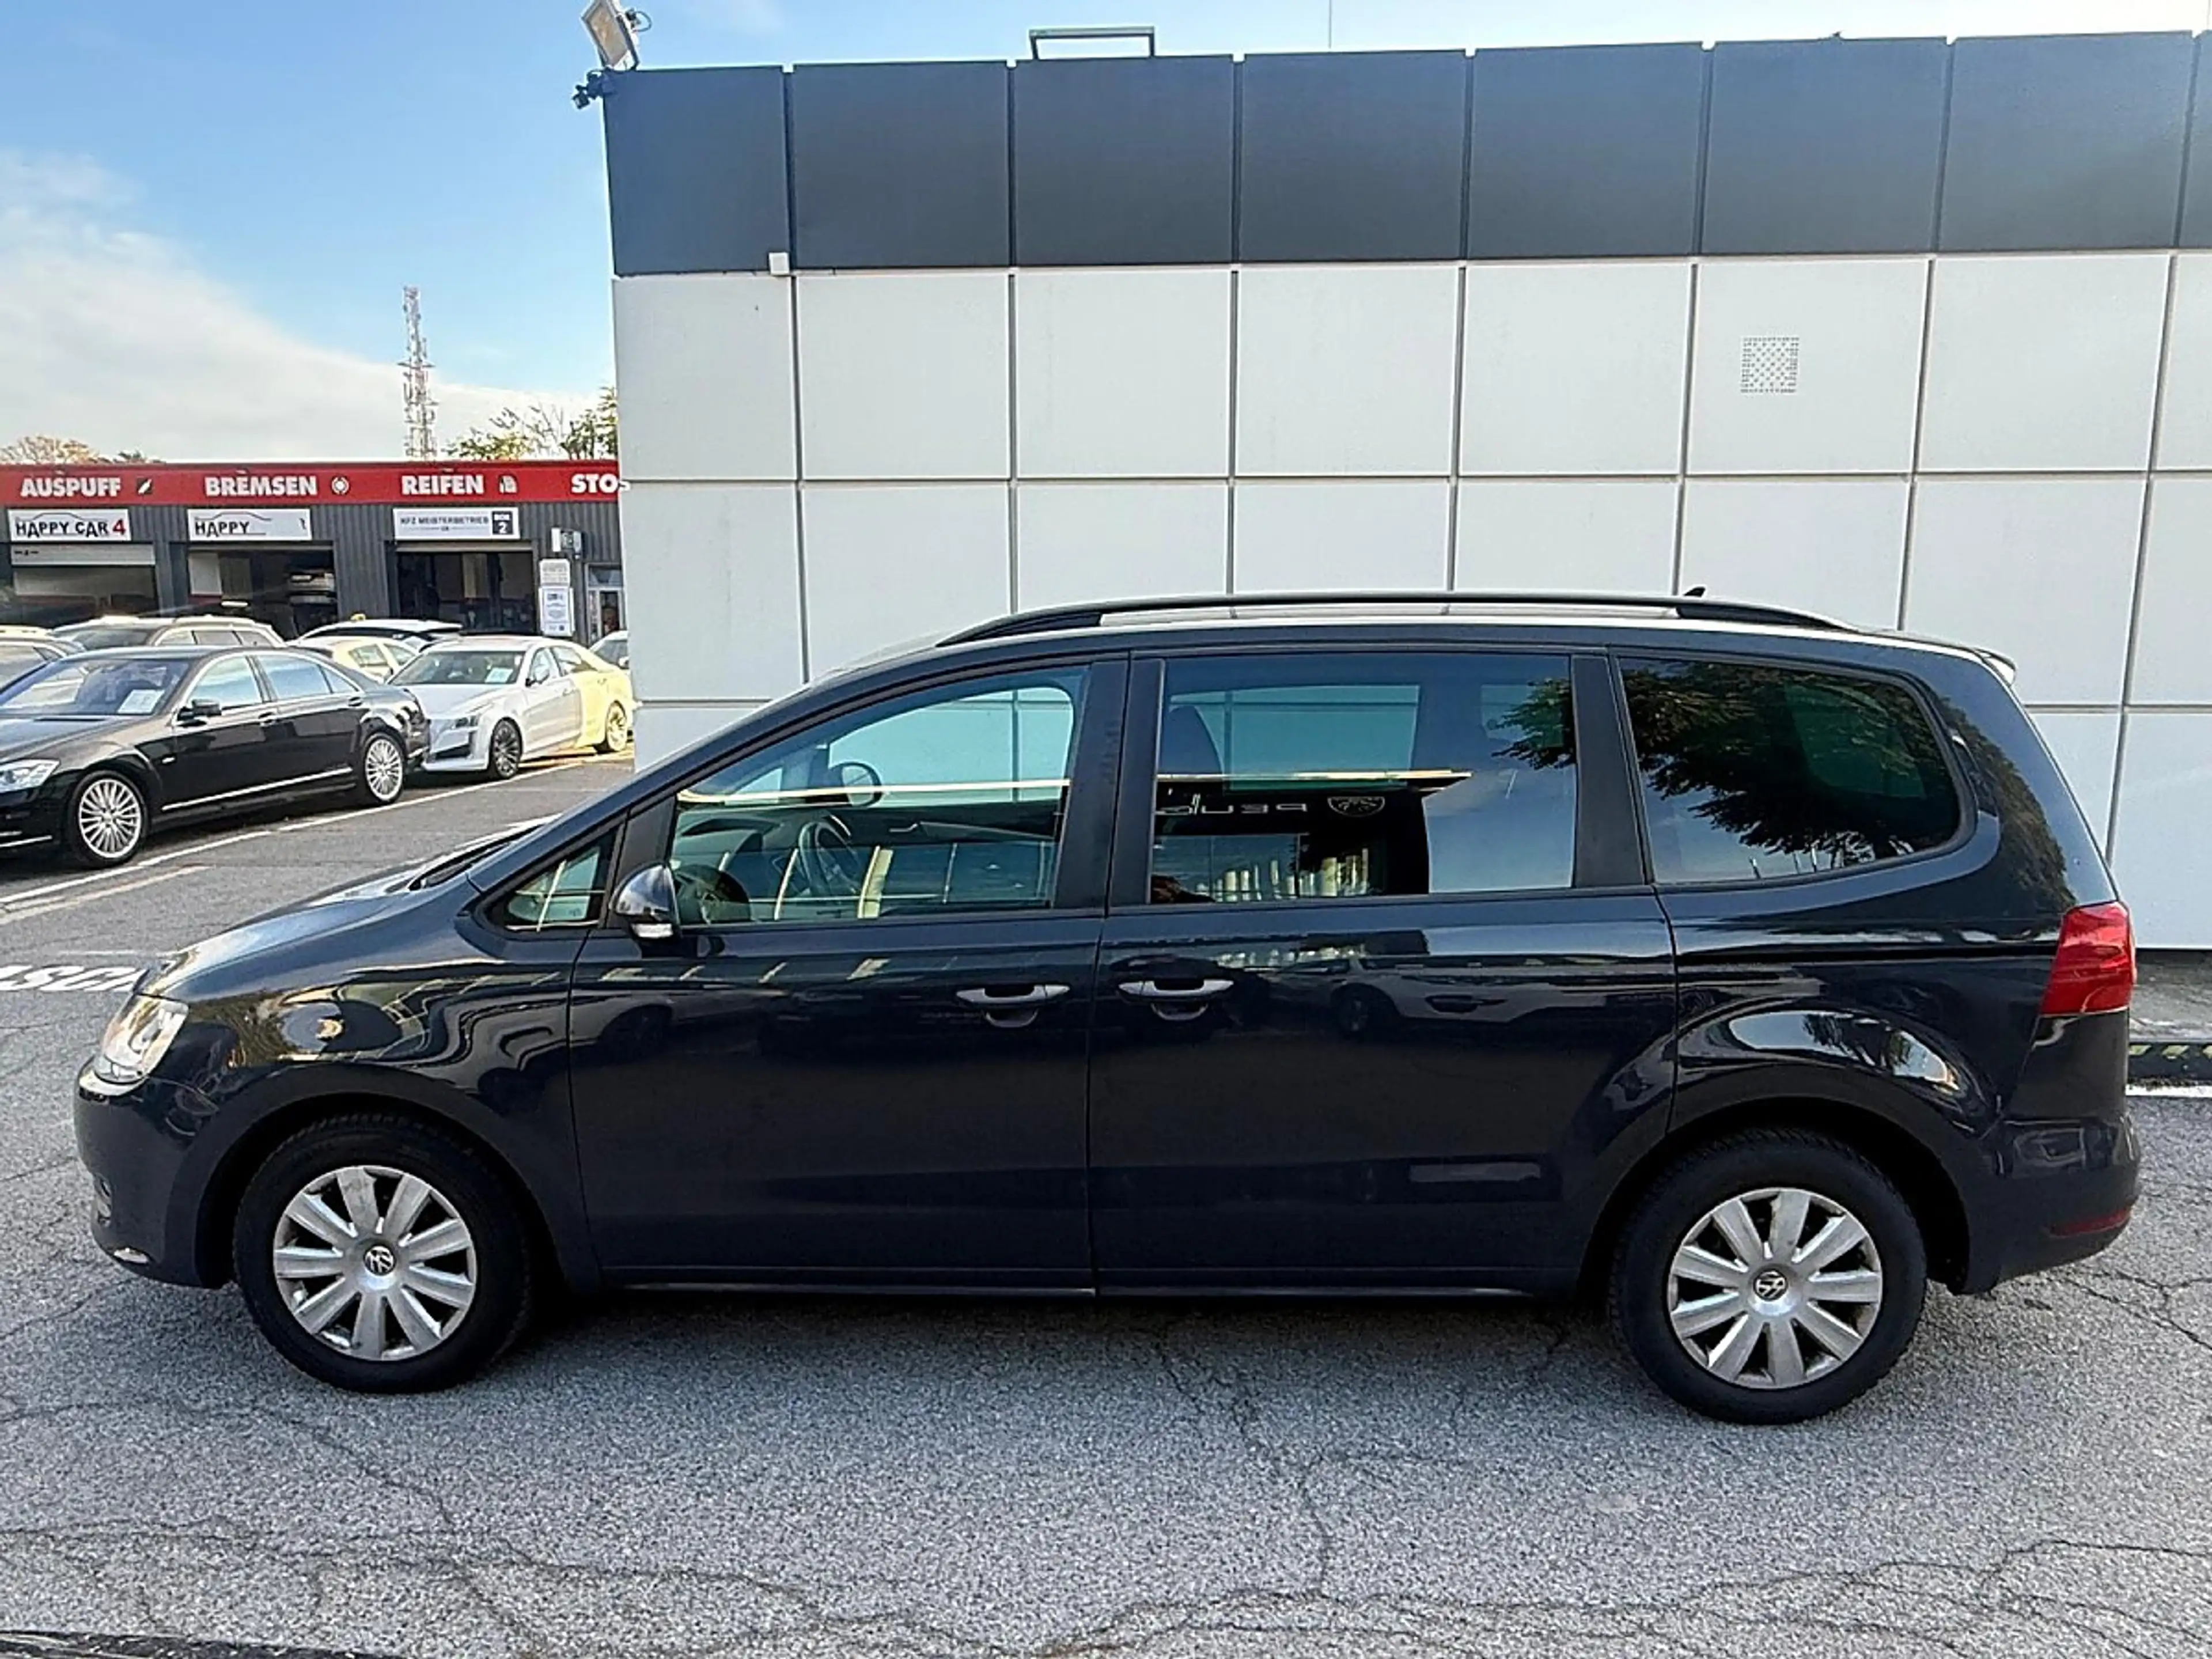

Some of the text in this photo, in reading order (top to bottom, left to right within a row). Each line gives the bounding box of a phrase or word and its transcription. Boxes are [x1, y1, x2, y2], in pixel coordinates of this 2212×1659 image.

[20, 477, 121, 497] AUSPUFF
[204, 475, 317, 497] BREMSEN
[401, 474, 484, 495] REIFEN
[16, 518, 127, 538] HAPPY CAR 4
[194, 521, 249, 537] HAPPY
[498, 522, 508, 534] 2
